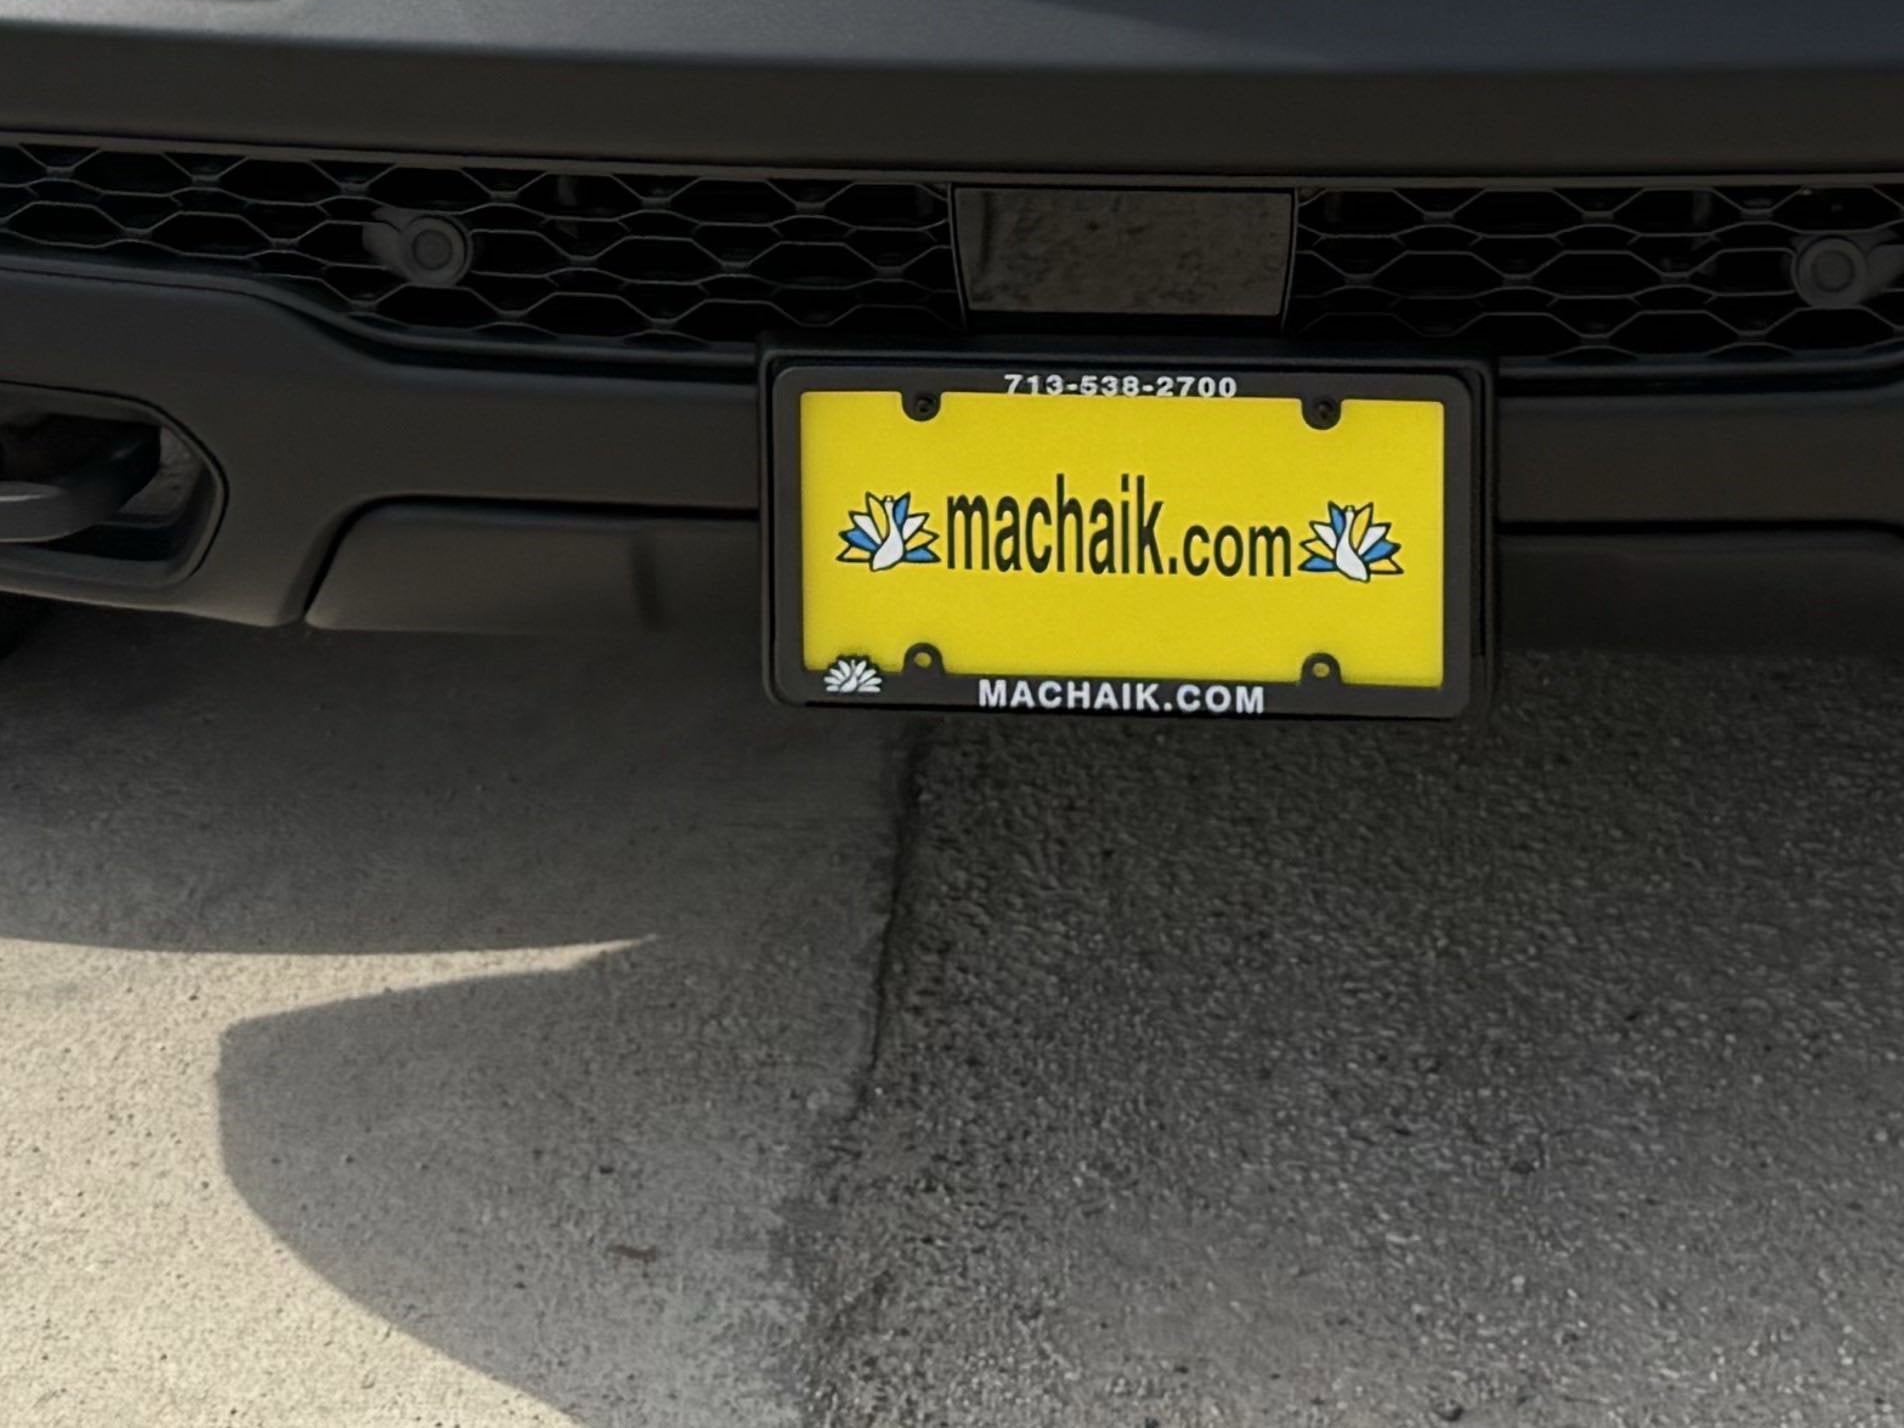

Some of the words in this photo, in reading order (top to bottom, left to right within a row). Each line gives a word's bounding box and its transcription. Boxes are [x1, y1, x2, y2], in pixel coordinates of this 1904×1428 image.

[1004, 374, 1237, 398] 713-538-2700
[946, 473, 1292, 577] machaik.com
[978, 680, 1265, 714] MACHAIK.COM
